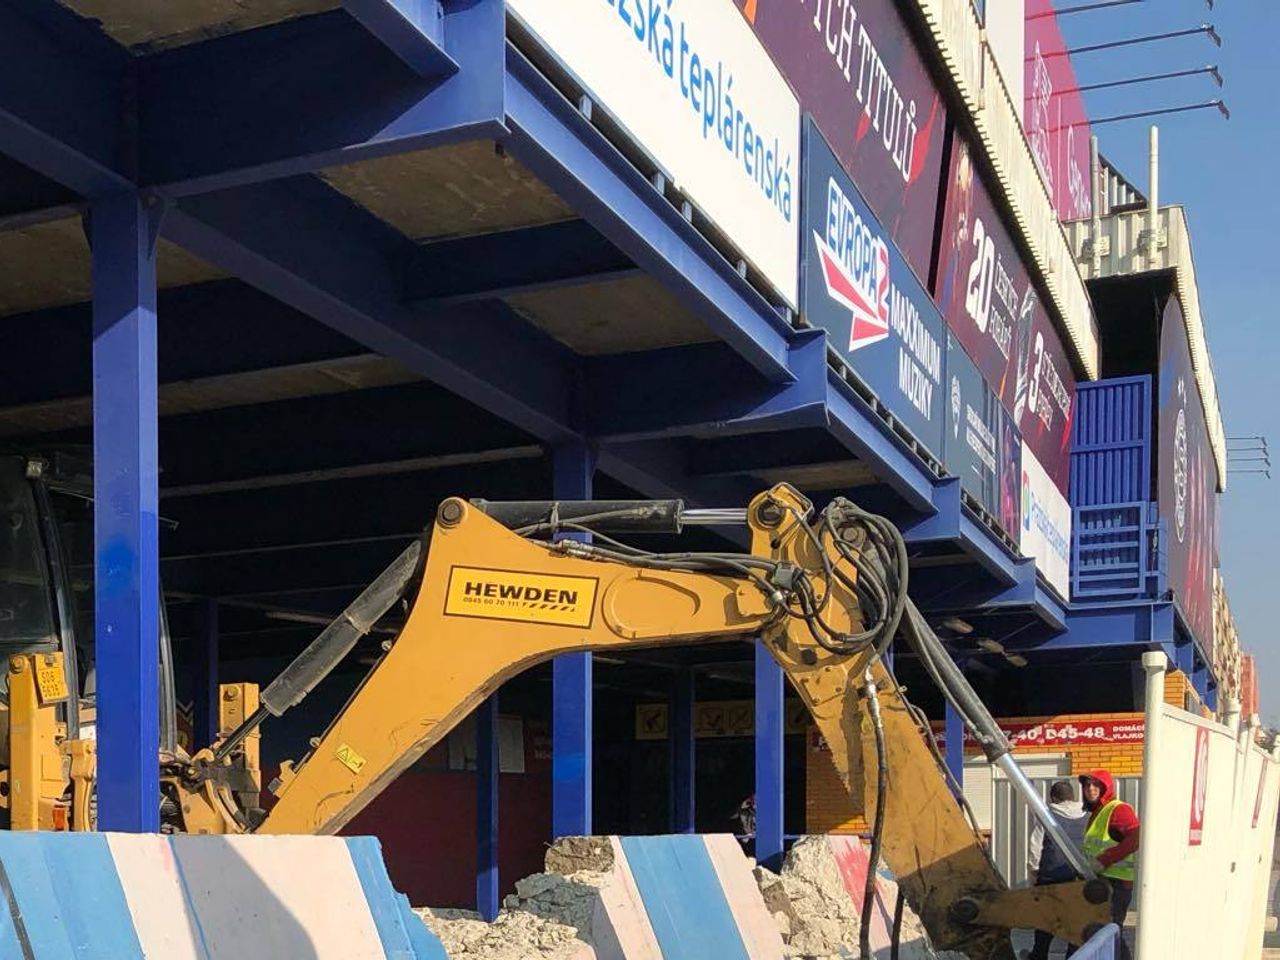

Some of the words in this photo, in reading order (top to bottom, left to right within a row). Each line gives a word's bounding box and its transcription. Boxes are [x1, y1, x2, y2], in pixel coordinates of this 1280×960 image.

[680, 22, 791, 223] teplárenská
[856, 24, 917, 182] TITULŮ
[966, 218, 995, 333] 20
[891, 283, 941, 384] MAXXIMUM
[899, 347, 933, 421] MUZIKY
[1029, 331, 1044, 413] 3
[465, 582, 578, 605] HEWDEN
